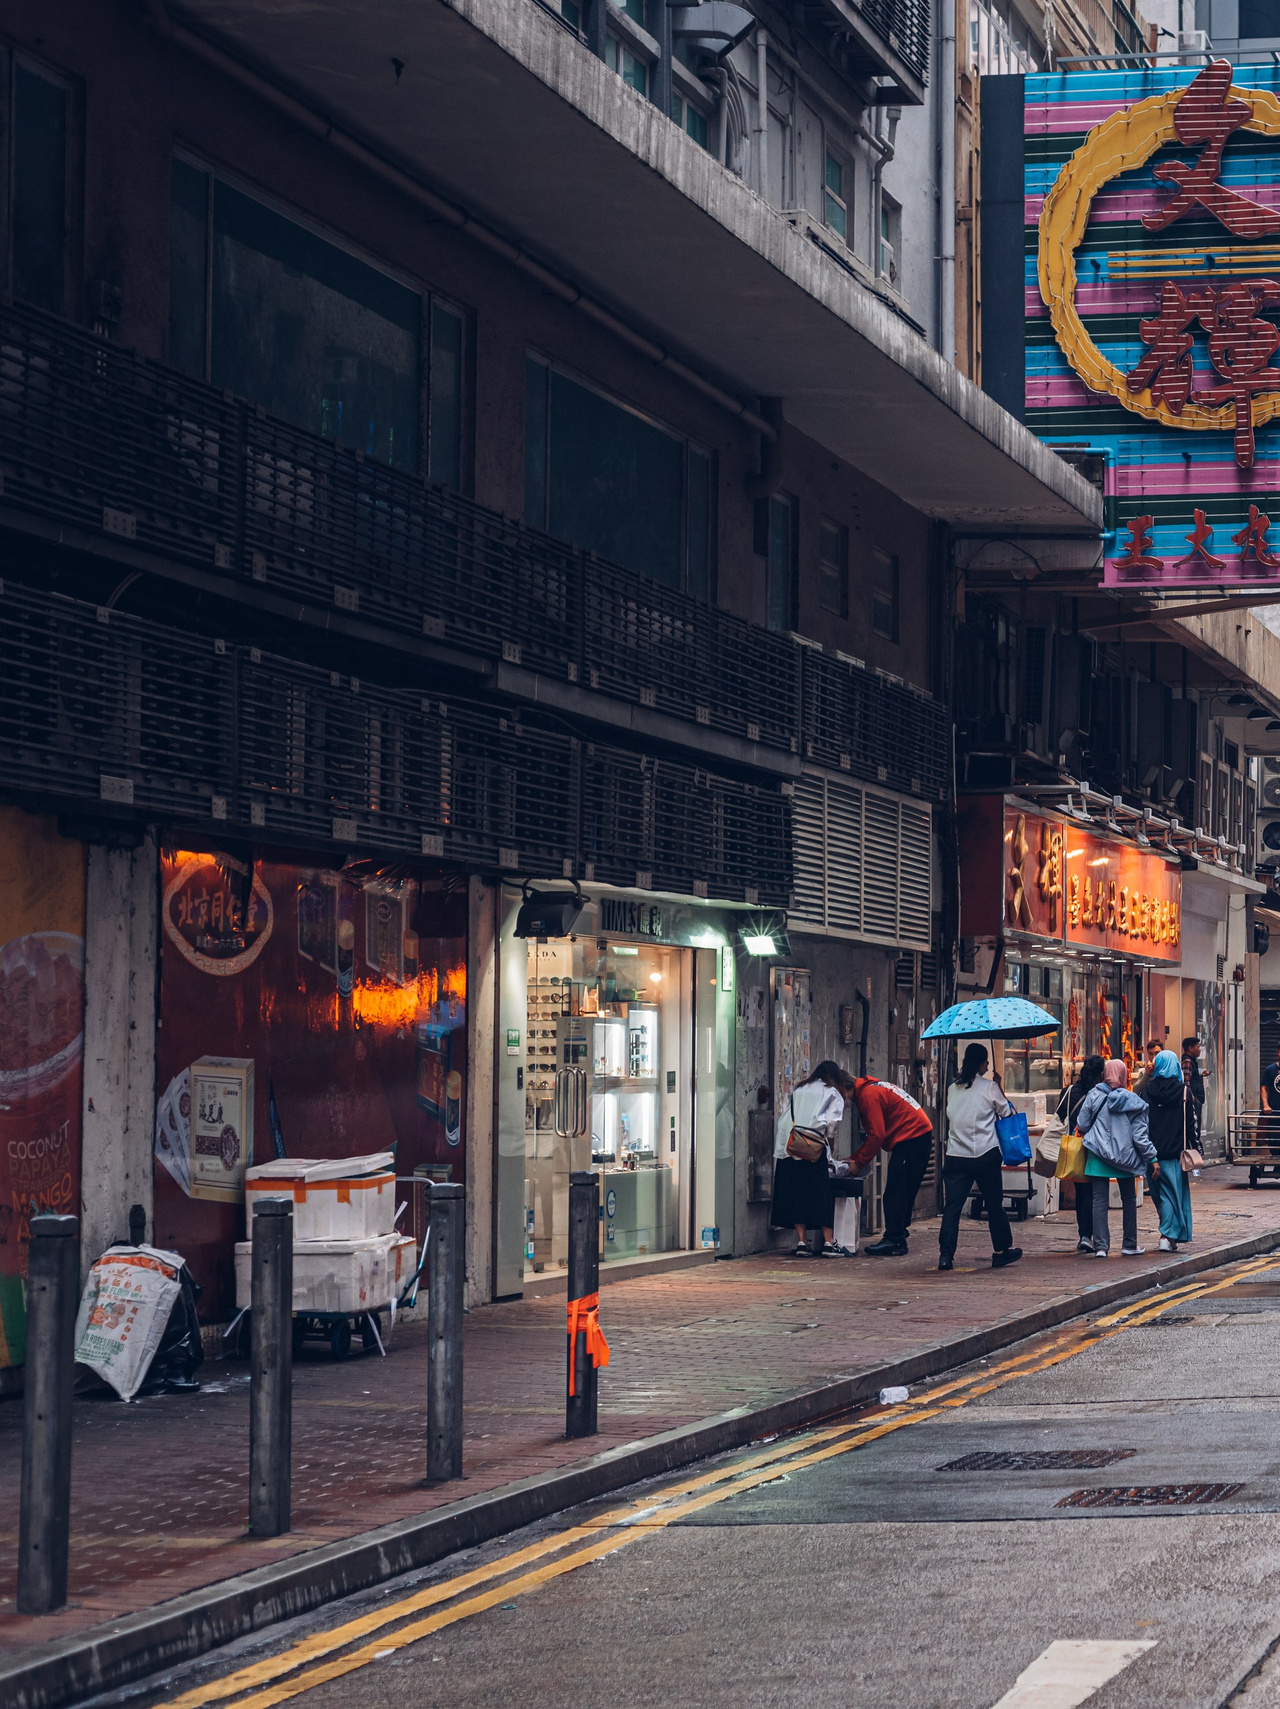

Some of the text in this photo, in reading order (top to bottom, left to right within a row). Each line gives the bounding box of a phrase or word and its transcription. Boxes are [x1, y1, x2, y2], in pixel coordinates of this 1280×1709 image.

[601, 898, 638, 933] TIMES
[8, 1120, 71, 1160] COCONUT
[9, 1142, 72, 1179] PAPAYA
[11, 1161, 71, 1190] STRAWBERRY
[11, 1172, 73, 1211] MANGO
[107, 1337, 125, 1353] BRAND
